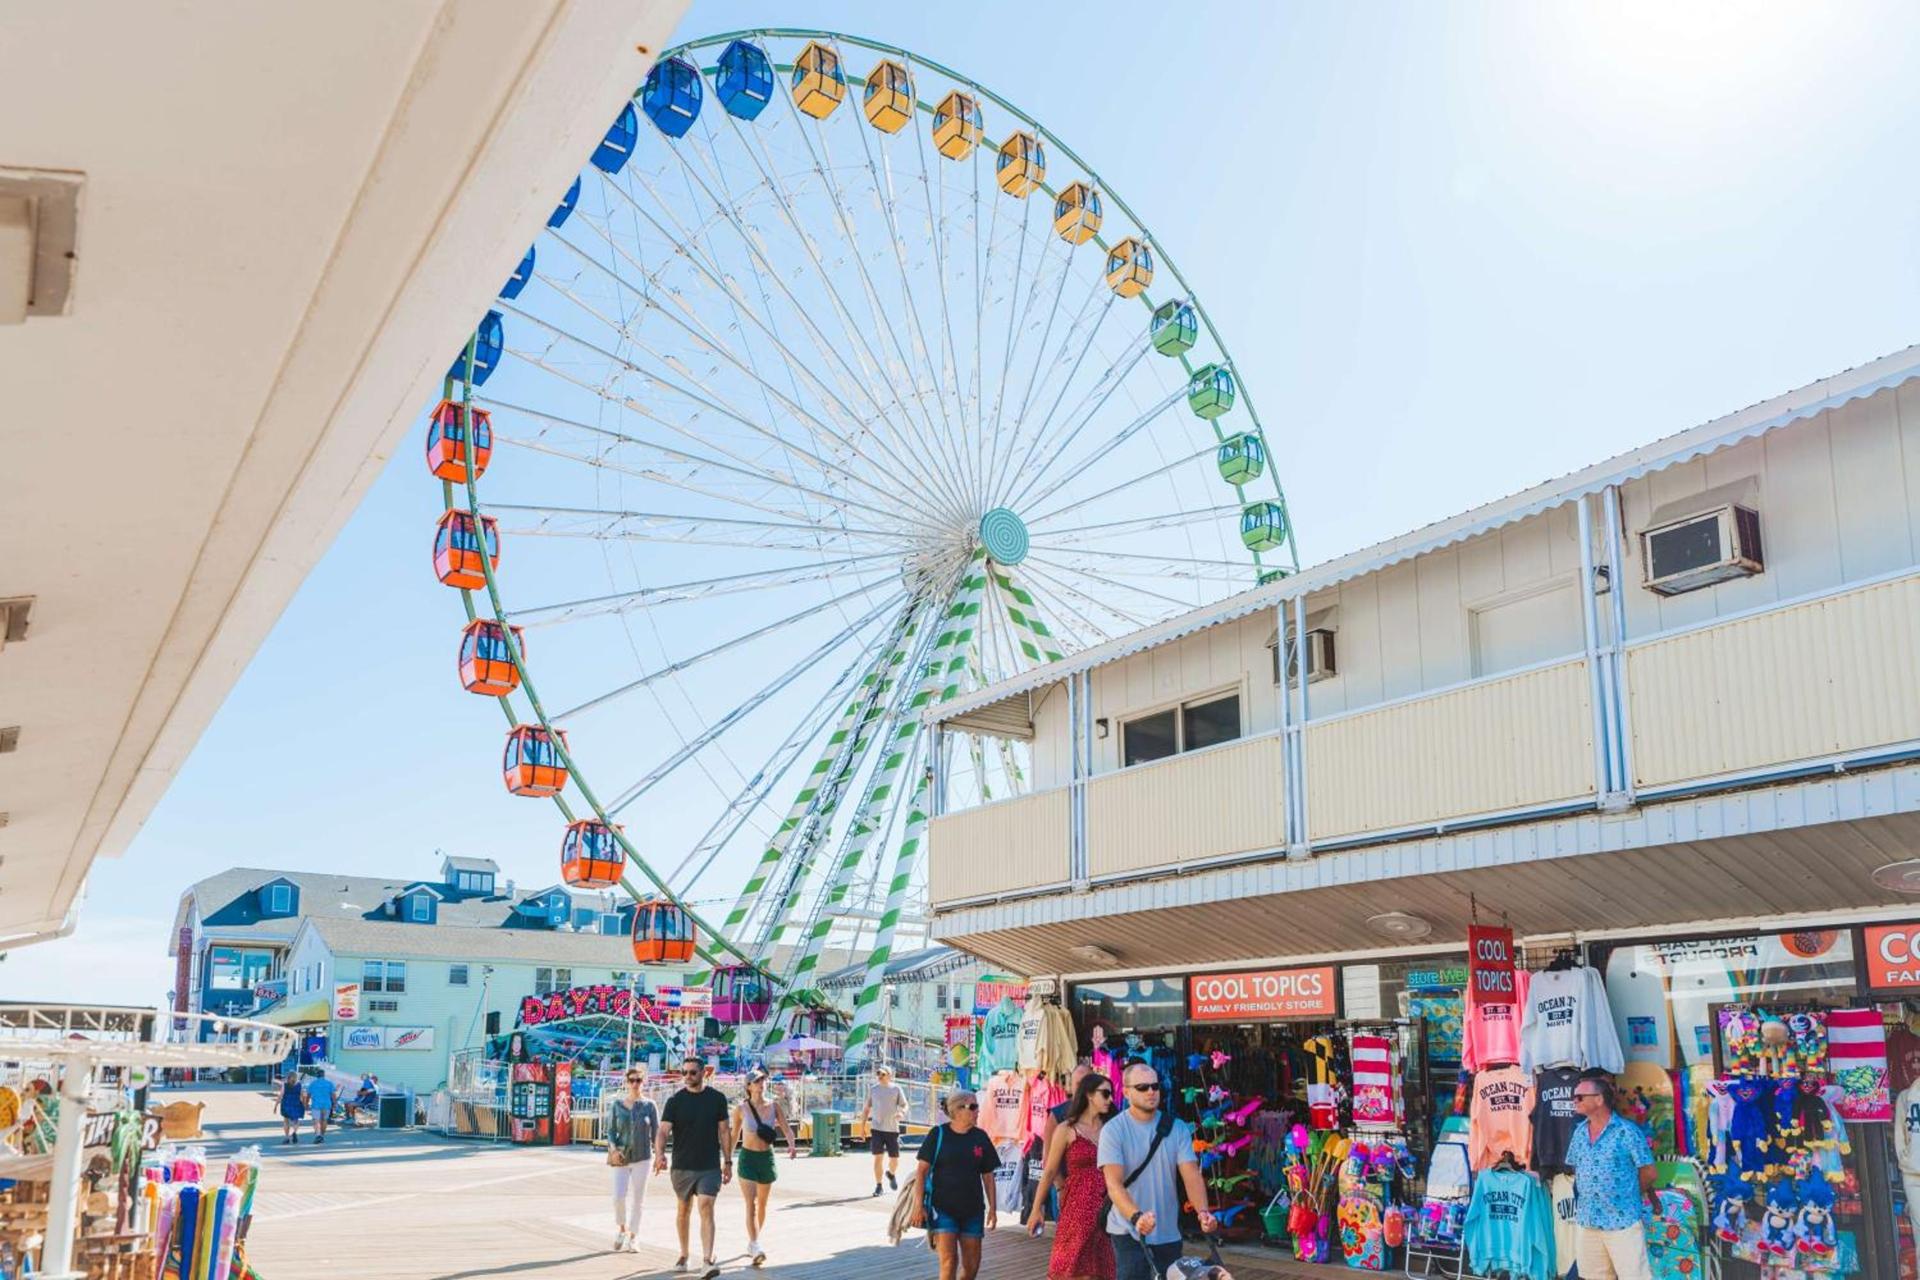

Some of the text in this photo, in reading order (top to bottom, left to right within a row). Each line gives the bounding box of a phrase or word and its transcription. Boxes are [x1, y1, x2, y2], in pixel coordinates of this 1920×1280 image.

[1477, 939, 1508, 961] COOL
[1195, 973, 1323, 1001] COOL TOPICS
[1475, 970, 1513, 992] TOPICS
[1197, 999, 1324, 1014] FAMILY FRIENDLY STORE
[1537, 996, 1565, 1014] OCEAN
[1479, 1081, 1508, 1100] OCEAN
[1508, 1081, 1528, 1098] CITY
[1541, 1086, 1572, 1102] OCEAN
